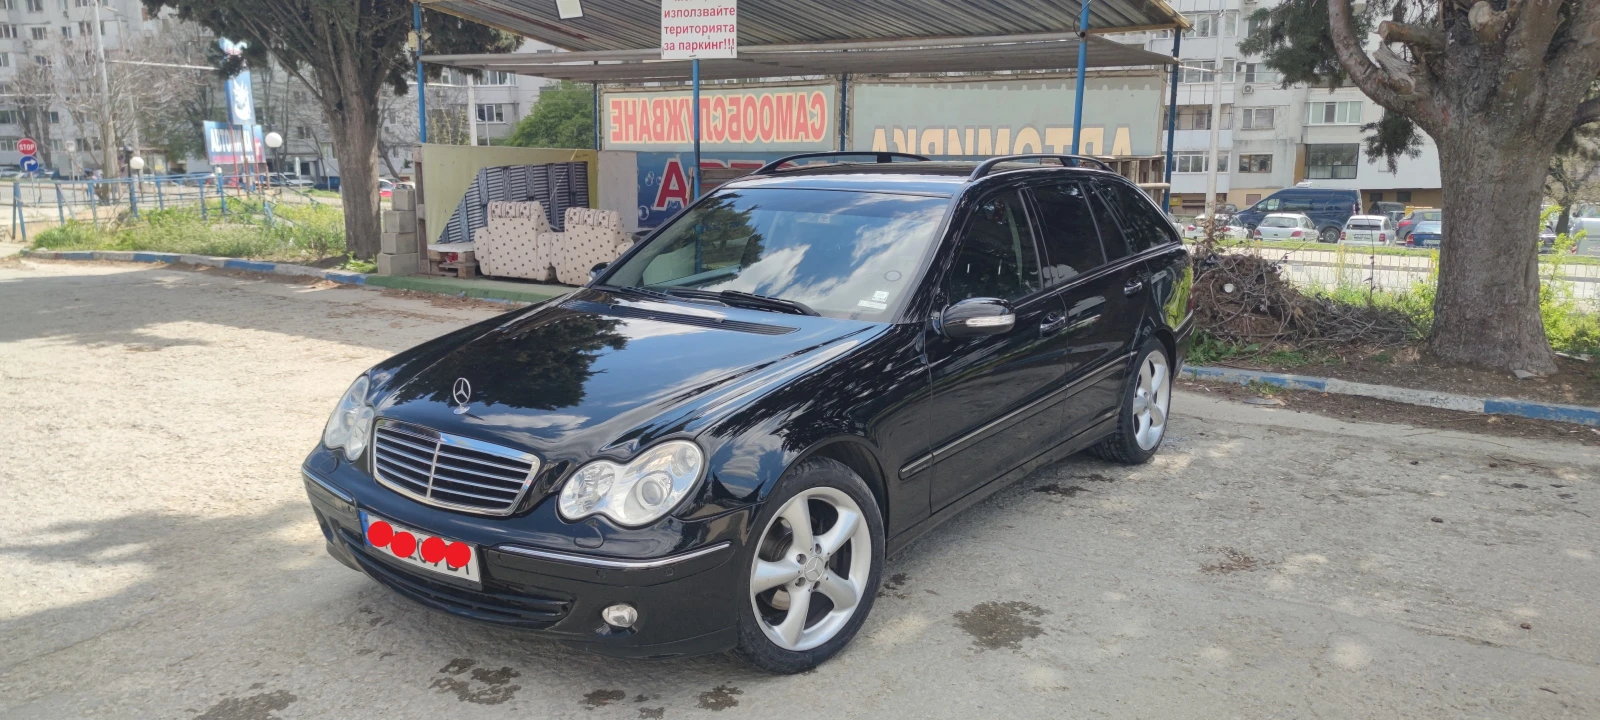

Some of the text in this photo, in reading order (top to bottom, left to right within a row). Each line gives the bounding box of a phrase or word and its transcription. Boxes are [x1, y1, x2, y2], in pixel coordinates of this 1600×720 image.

[664, 5, 736, 18] използвайте
[664, 24, 735, 37] територията
[664, 38, 735, 53] за паркинг!!!
